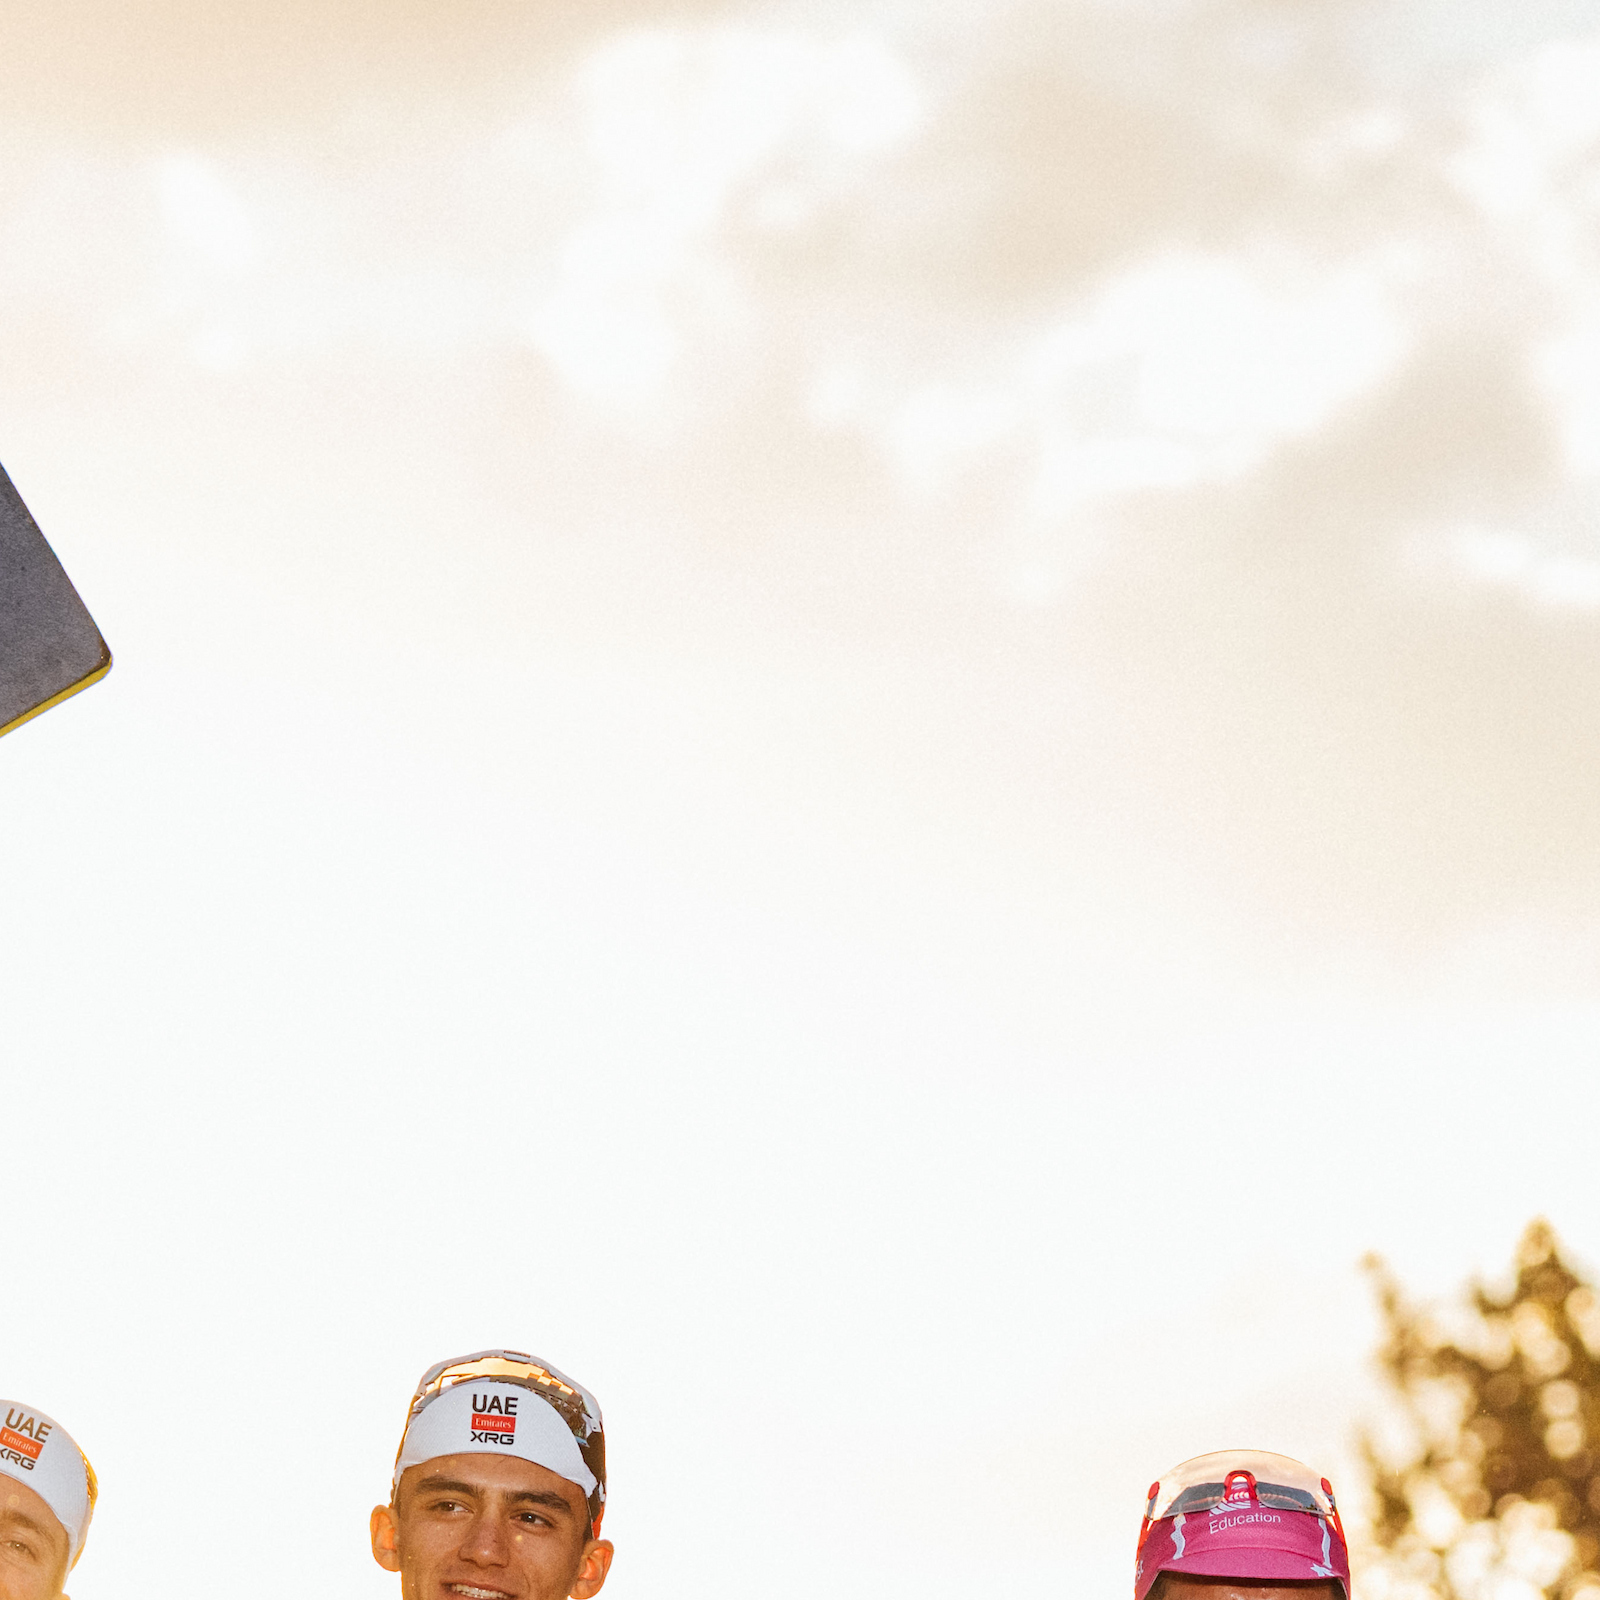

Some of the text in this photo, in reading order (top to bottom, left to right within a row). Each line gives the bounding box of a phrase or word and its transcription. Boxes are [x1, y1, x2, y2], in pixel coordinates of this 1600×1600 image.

[472, 1394, 518, 1416] UAE
[5, 1408, 53, 1443] UAE
[475, 1418, 512, 1429] Emirates
[2, 1432, 37, 1454] Emirates
[470, 1431, 514, 1445] XRG
[1209, 1513, 1281, 1534] Education
